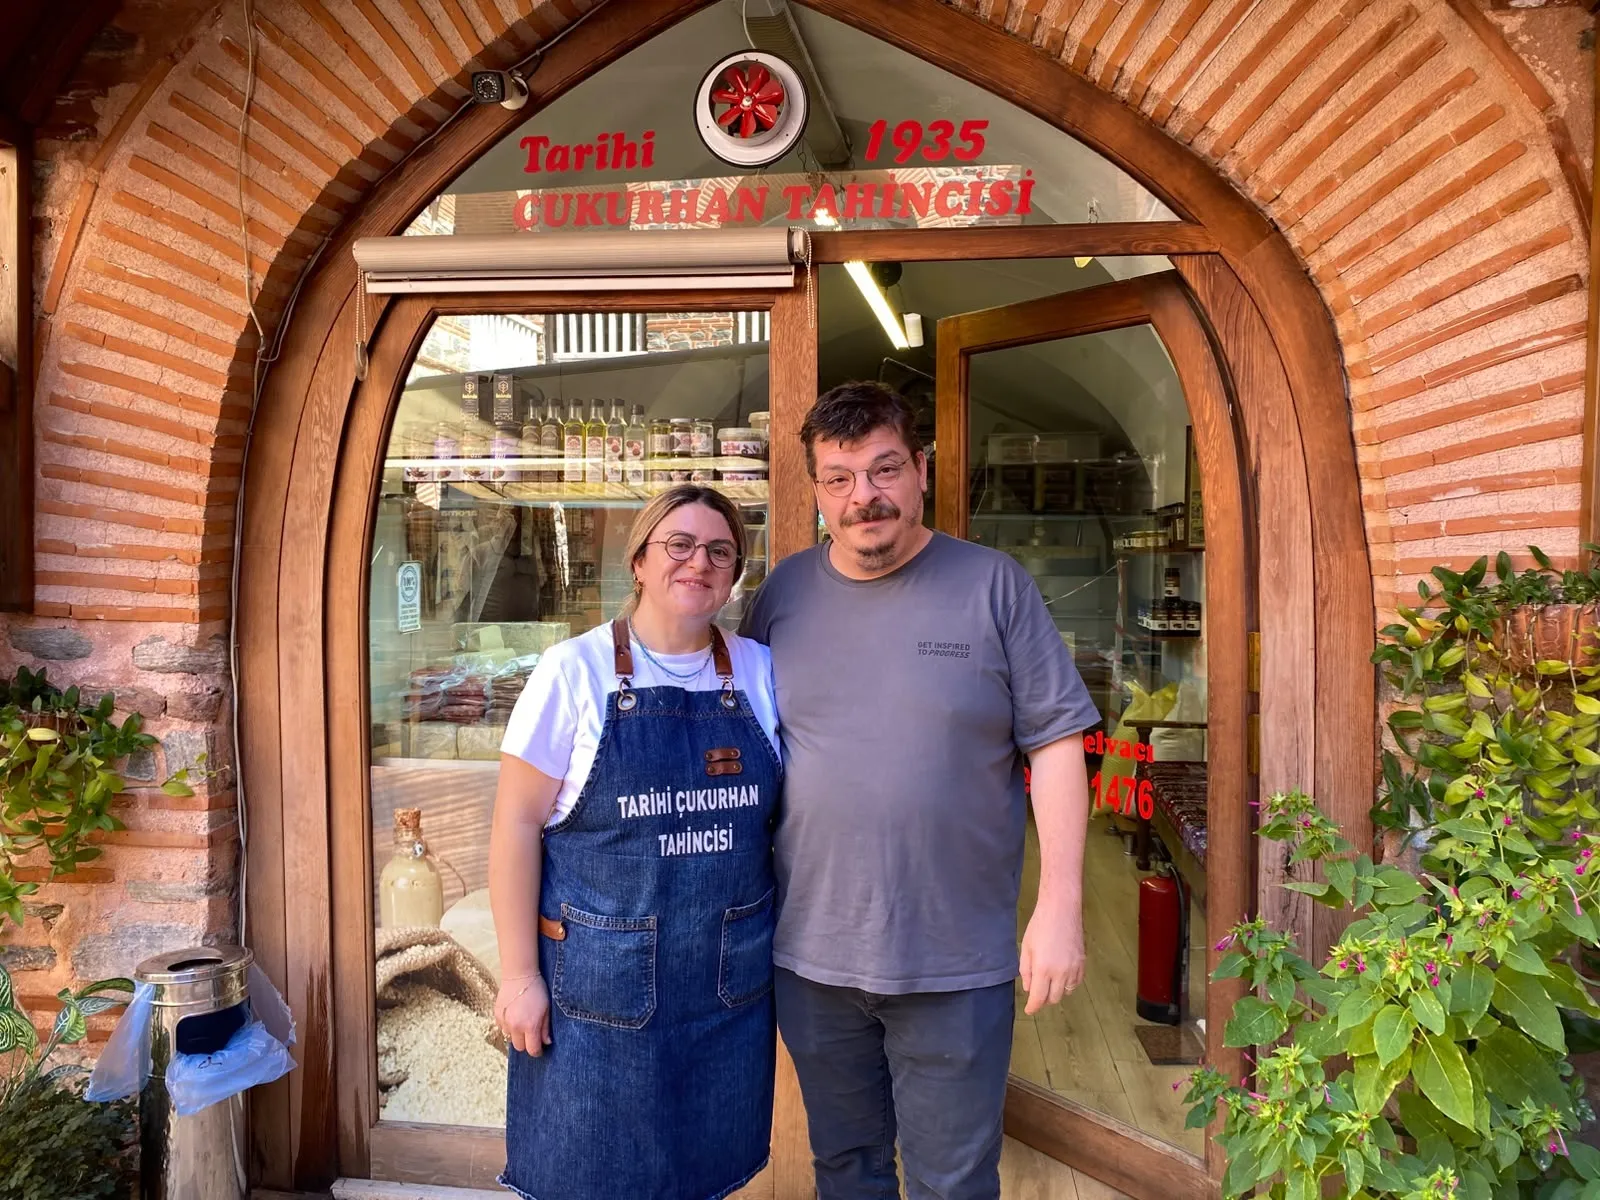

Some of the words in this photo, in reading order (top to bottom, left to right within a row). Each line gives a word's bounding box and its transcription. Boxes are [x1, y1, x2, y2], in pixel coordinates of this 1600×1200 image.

[519, 130, 656, 173] Tarihi
[864, 119, 990, 162] 1935
[782, 169, 1036, 220] TAHİNCİSİ
[917, 641, 933, 649] GET
[934, 642, 971, 651] INSPIRED
[928, 649, 971, 659] PROGRESS
[1083, 730, 1155, 763] elvacı
[617, 786, 672, 818] TARİHİ
[675, 784, 759, 818] ÇUKURHAN
[1090, 770, 1154, 820] 1476
[658, 823, 733, 856] TAHİNCİSİ
